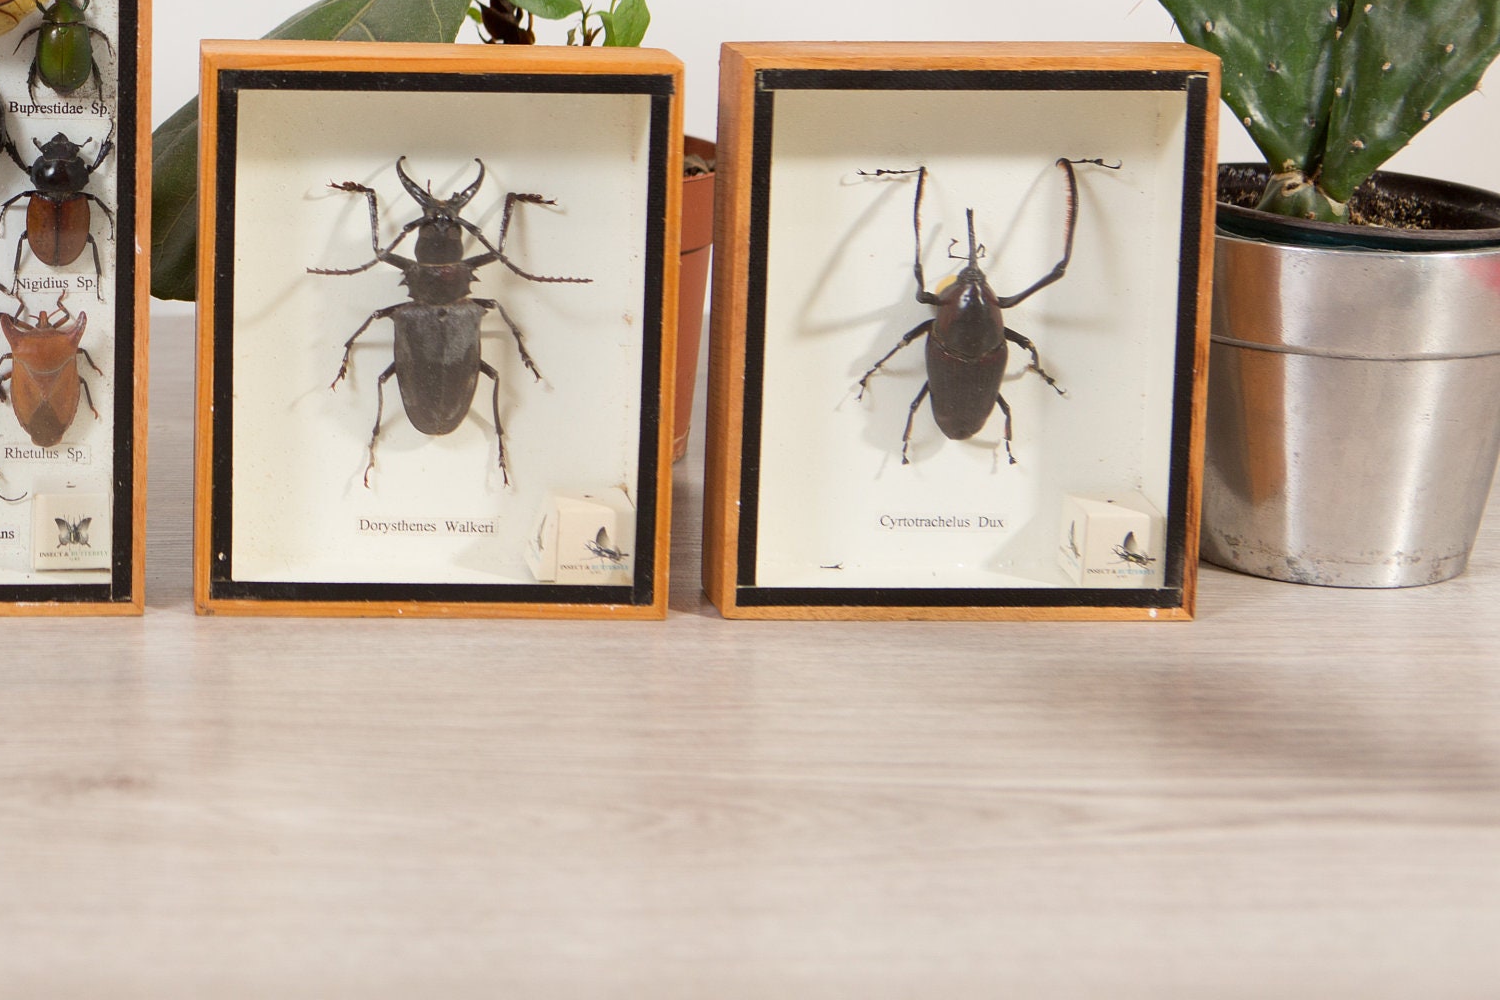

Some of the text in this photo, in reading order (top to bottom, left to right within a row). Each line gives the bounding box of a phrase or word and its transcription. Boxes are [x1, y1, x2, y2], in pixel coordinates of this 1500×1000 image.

[91, 102, 111, 117] Sp.
[16, 276, 96, 292] Nigidius Sp.
[4, 446, 86, 462] Rhetulus Sp.
[359, 519, 494, 534] Dorysthenes Walkeri
[879, 514, 1004, 530] Cyrtotrachelus Dux
